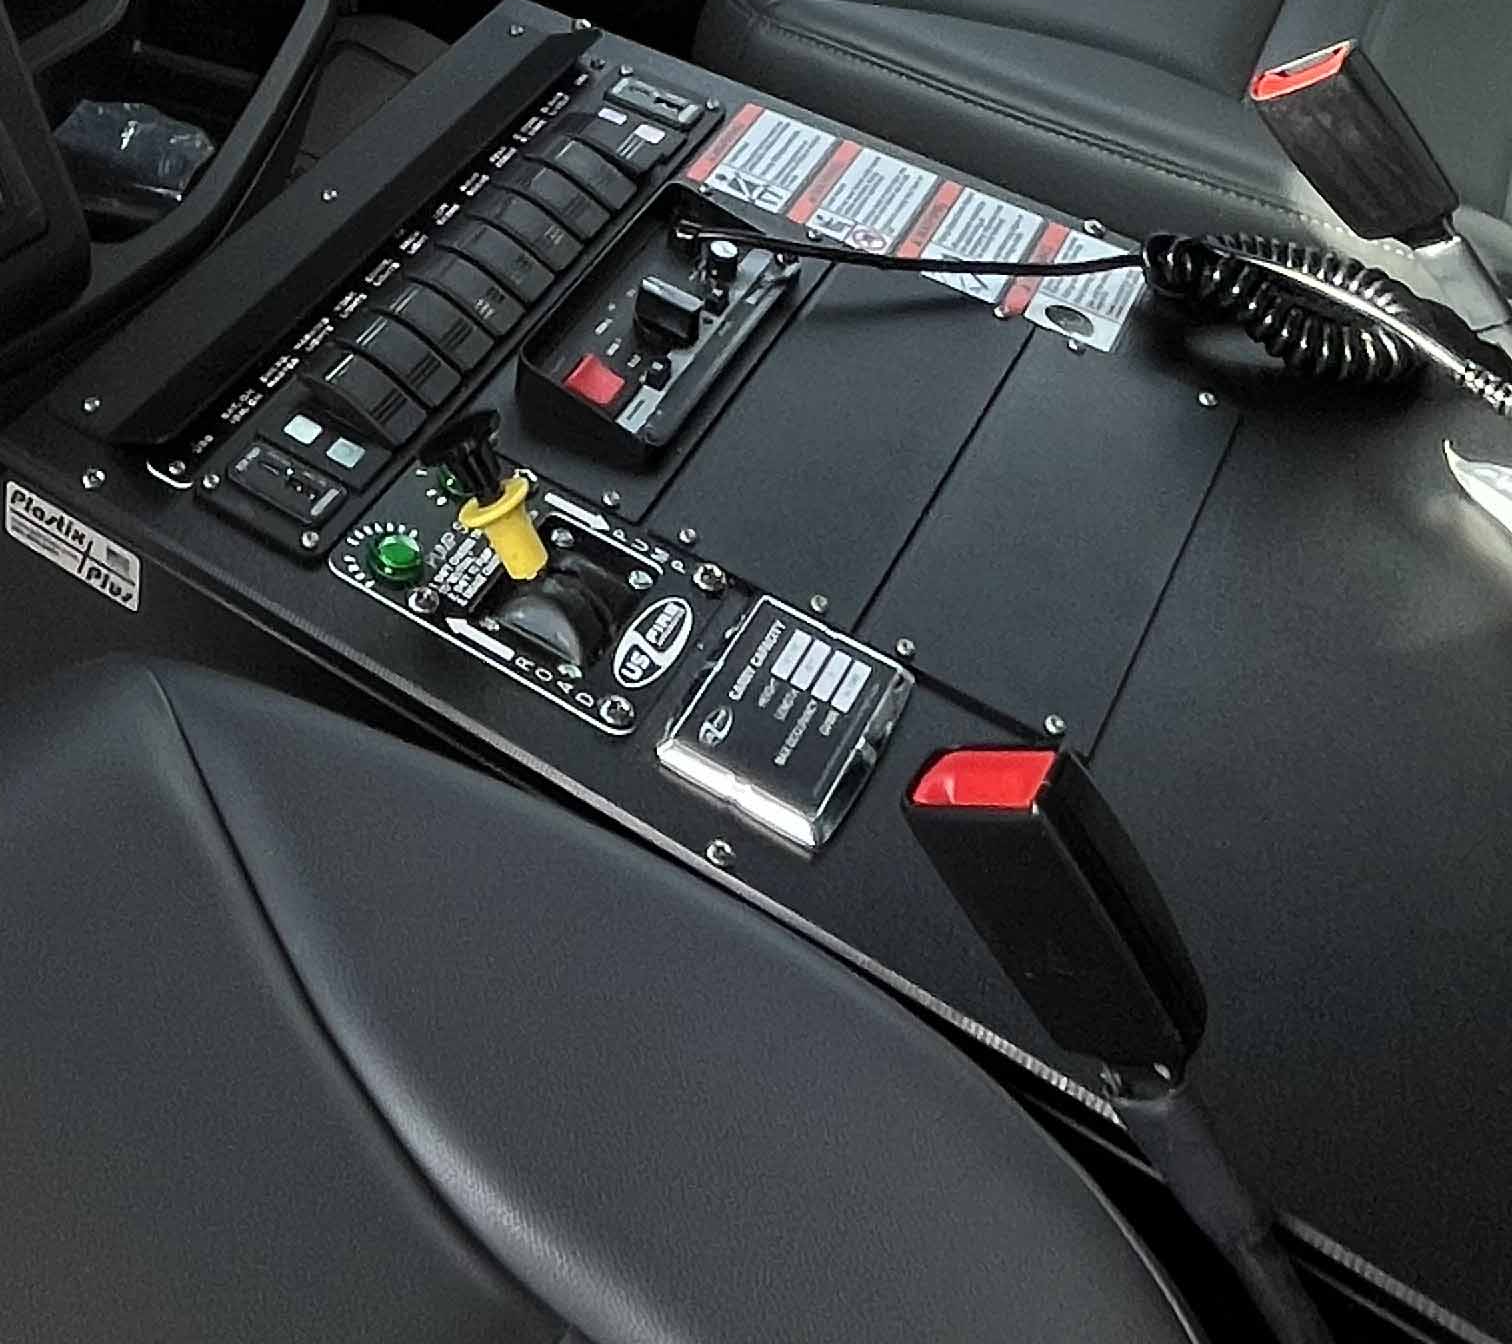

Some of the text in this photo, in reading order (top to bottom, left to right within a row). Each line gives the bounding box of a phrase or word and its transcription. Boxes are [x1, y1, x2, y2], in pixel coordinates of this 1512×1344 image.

[10, 489, 86, 546] Plastix
[613, 528, 686, 574] PUMP
[86, 566, 133, 602] Plus
[645, 602, 685, 647] FIRE
[515, 656, 595, 709] ROAD
[620, 649, 651, 681] US
